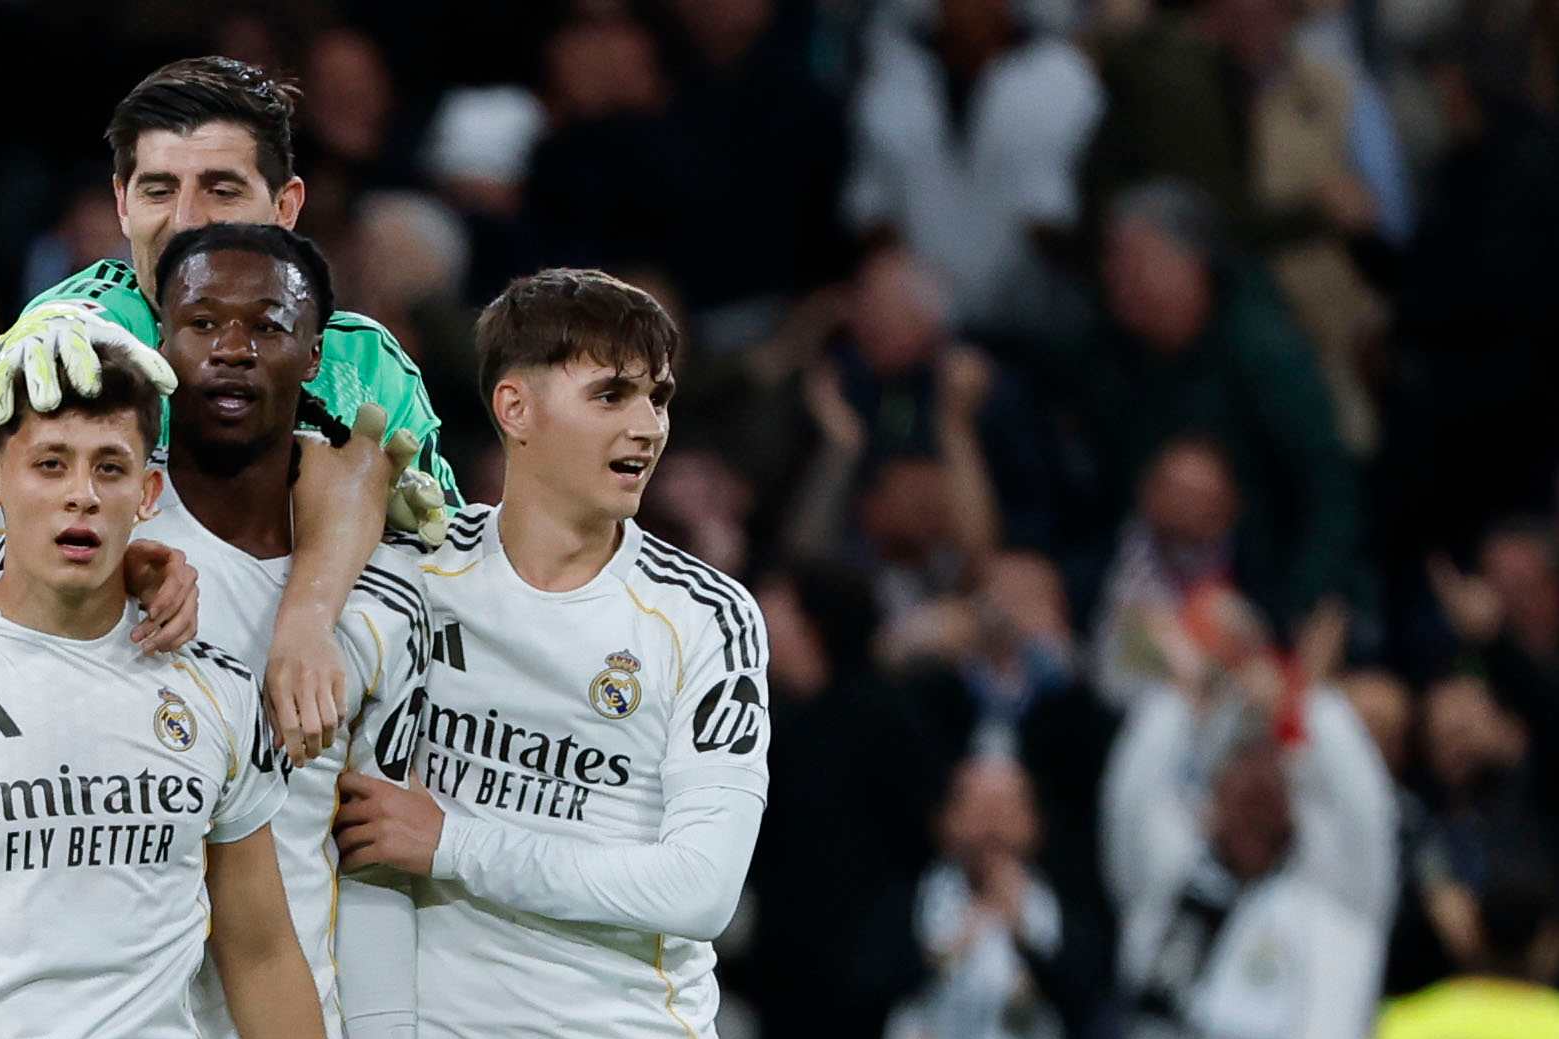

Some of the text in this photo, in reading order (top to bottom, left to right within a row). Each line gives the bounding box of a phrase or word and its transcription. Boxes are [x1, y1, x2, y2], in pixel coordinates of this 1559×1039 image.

[418, 700, 631, 787] mirates
[692, 675, 767, 755] hp
[425, 751, 591, 822] FLY BETTER
[5, 824, 175, 872] FLY BETTER
